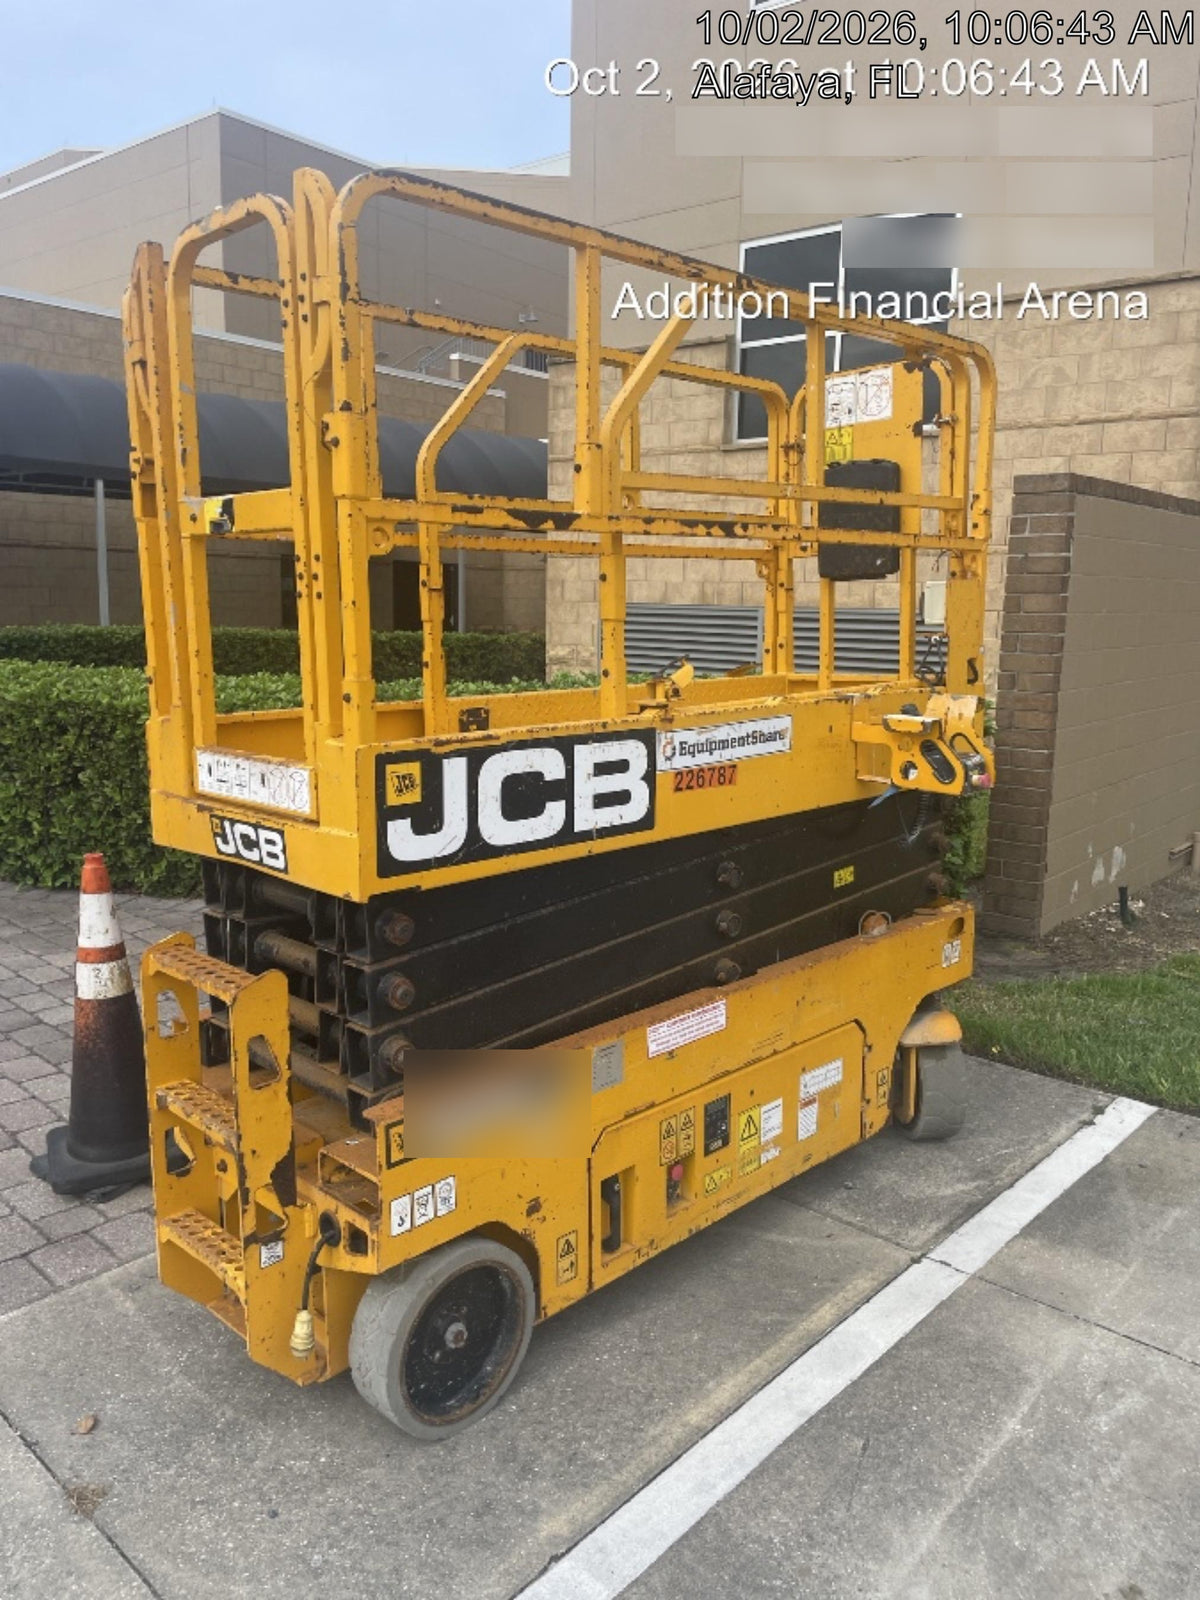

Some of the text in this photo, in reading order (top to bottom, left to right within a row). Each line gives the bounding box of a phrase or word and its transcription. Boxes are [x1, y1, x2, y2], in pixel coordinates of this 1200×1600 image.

[386, 738, 650, 862] JCB
[673, 764, 737, 793] 226787
[214, 820, 286, 871] JCB
